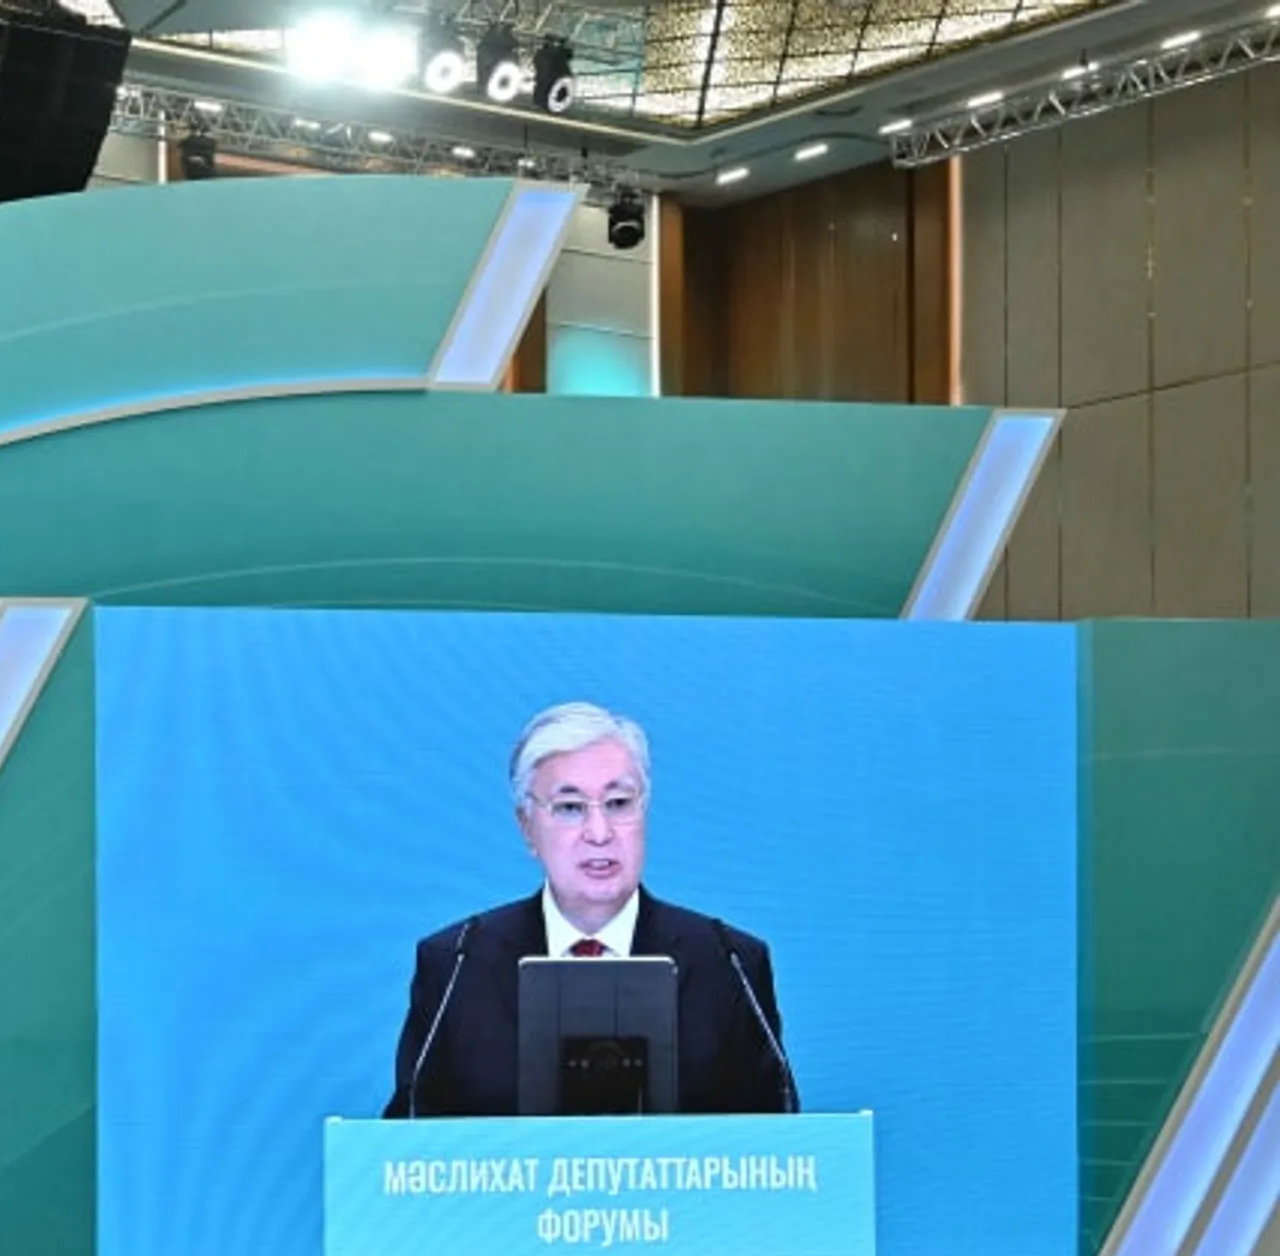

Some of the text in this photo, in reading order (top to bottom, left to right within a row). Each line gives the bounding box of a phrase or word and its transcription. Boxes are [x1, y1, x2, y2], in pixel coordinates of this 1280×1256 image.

[384, 1156, 816, 1197] МӘСЛИХАТ ДЕПУТАТТАРЫНЫҢ
[538, 1208, 669, 1246] ФОРУМЫ
